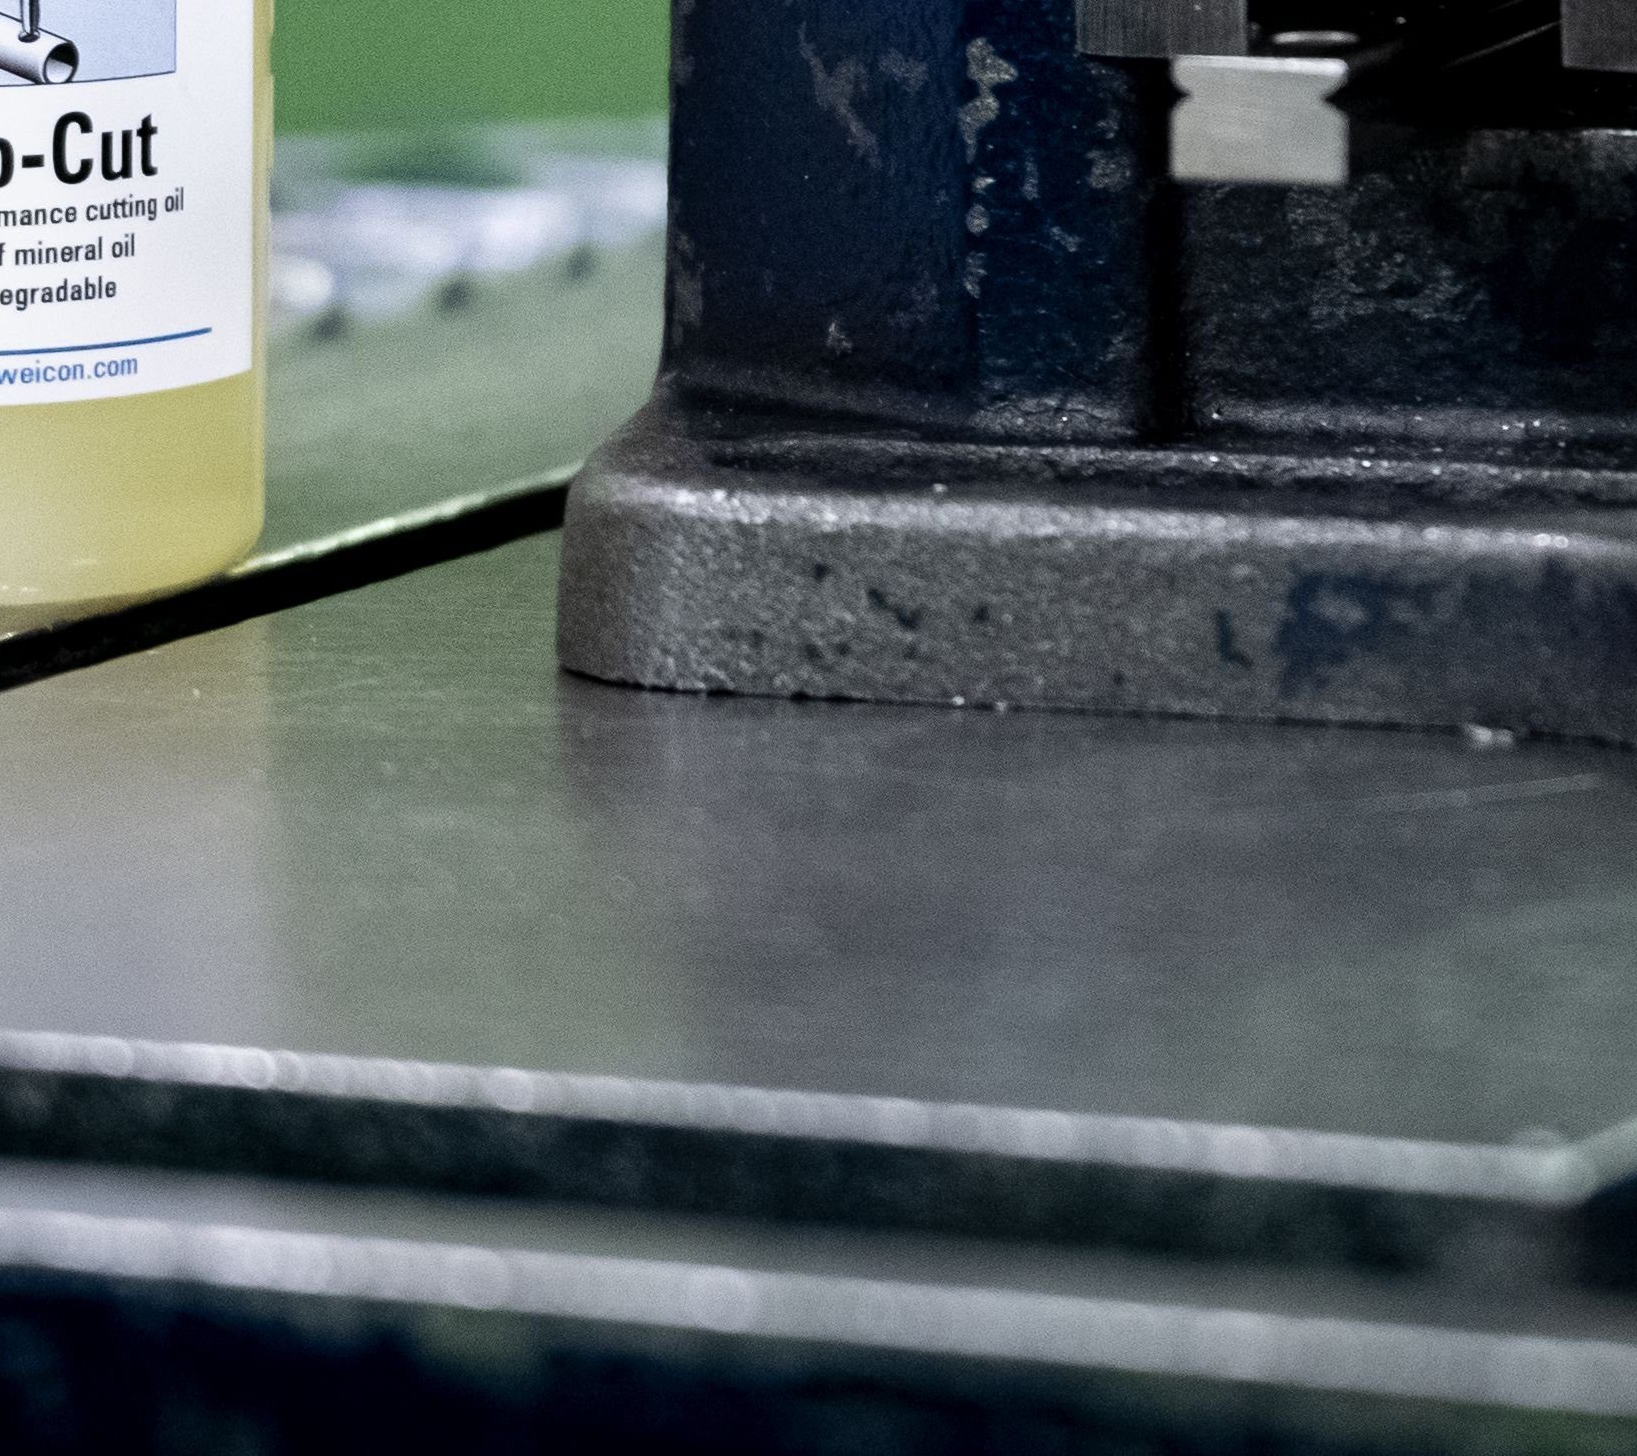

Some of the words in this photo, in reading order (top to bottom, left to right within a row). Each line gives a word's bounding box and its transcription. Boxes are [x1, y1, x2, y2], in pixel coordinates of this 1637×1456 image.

[85, 195, 157, 222] cutting
[164, 186, 185, 213] oil
[14, 235, 103, 266] mineral
[111, 232, 135, 259] oil
